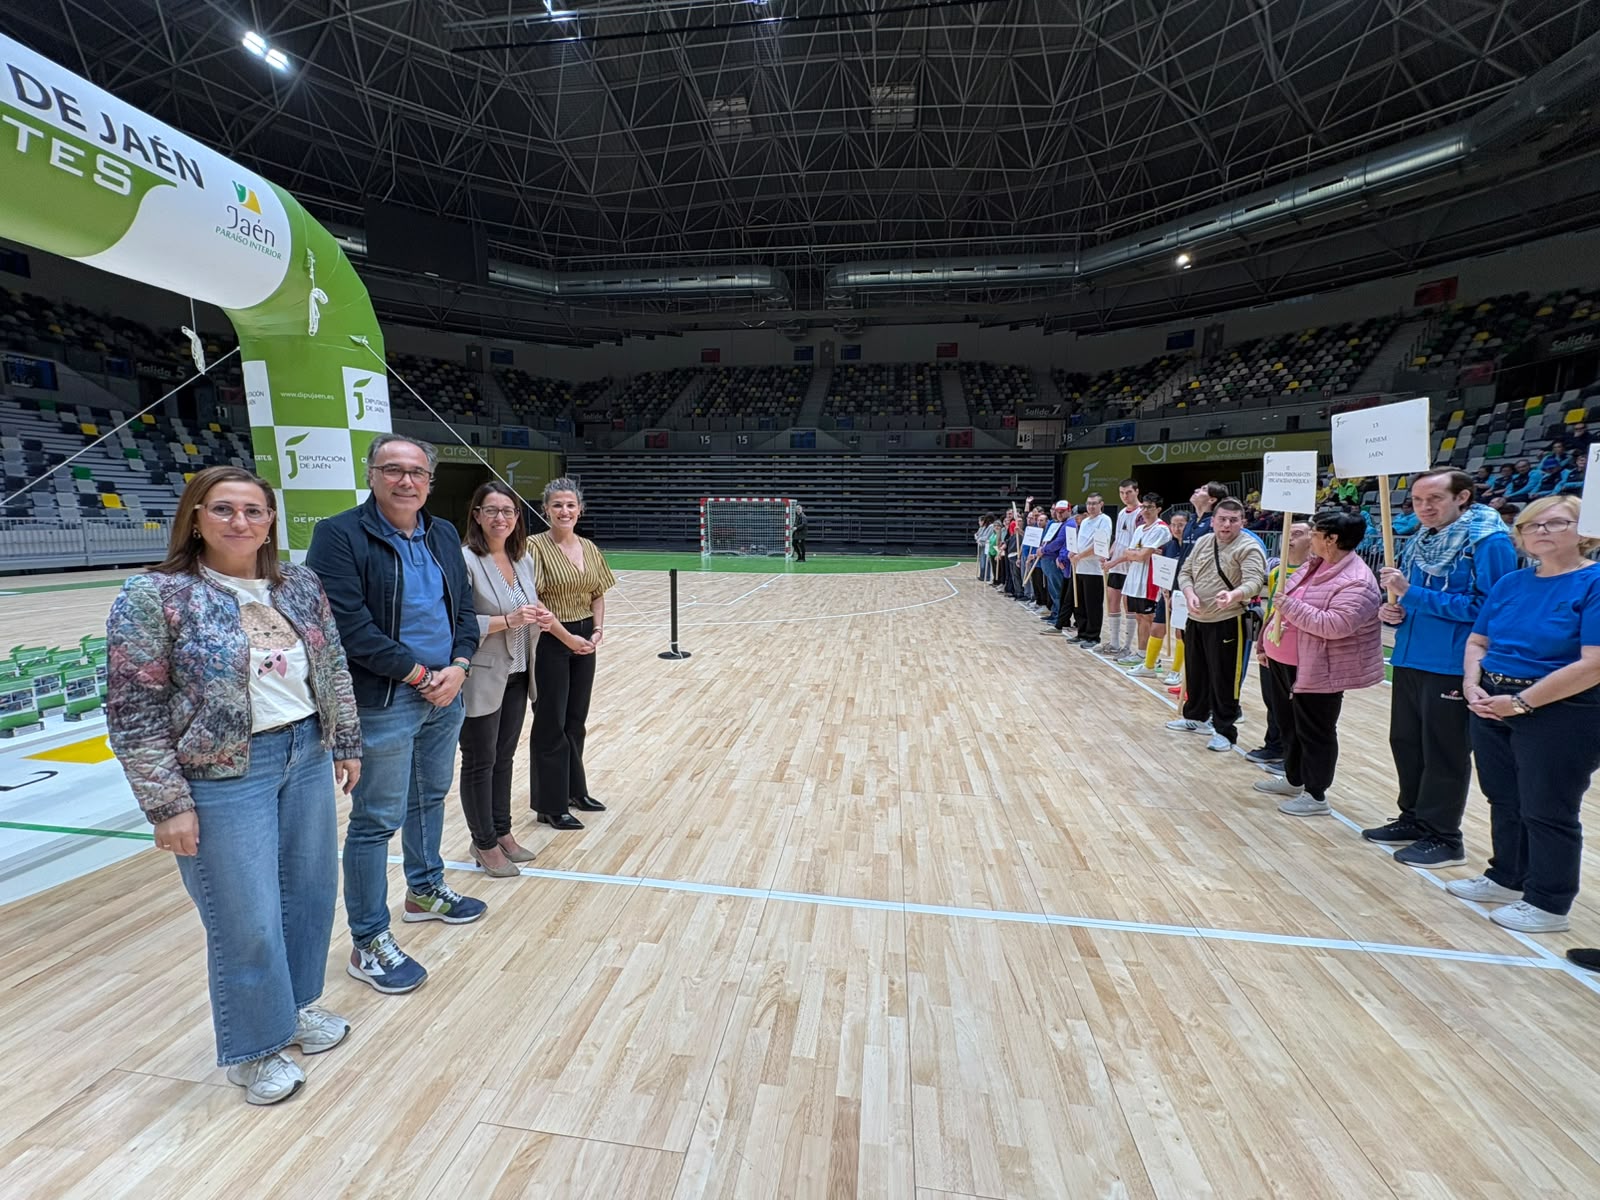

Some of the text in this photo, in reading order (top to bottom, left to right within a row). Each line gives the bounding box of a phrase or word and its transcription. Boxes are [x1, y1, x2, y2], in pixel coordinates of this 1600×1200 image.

[6, 62, 205, 190] DE JAÉN
[226, 205, 275, 248] Jaén
[215, 226, 282, 260] PARAÍSO INTERIOR
[136, 361, 186, 379] Salida 5
[280, 391, 335, 401] www.dipujaen.es
[1024, 404, 1062, 416] Salida 7
[700, 435, 710, 445] 15
[737, 435, 747, 445] 15
[1171, 440, 1211, 456] olivo
[1216, 437, 1276, 452] arena
[298, 454, 346, 463] DIPUTACIÓN
[311, 462, 332, 470] JAÉN
